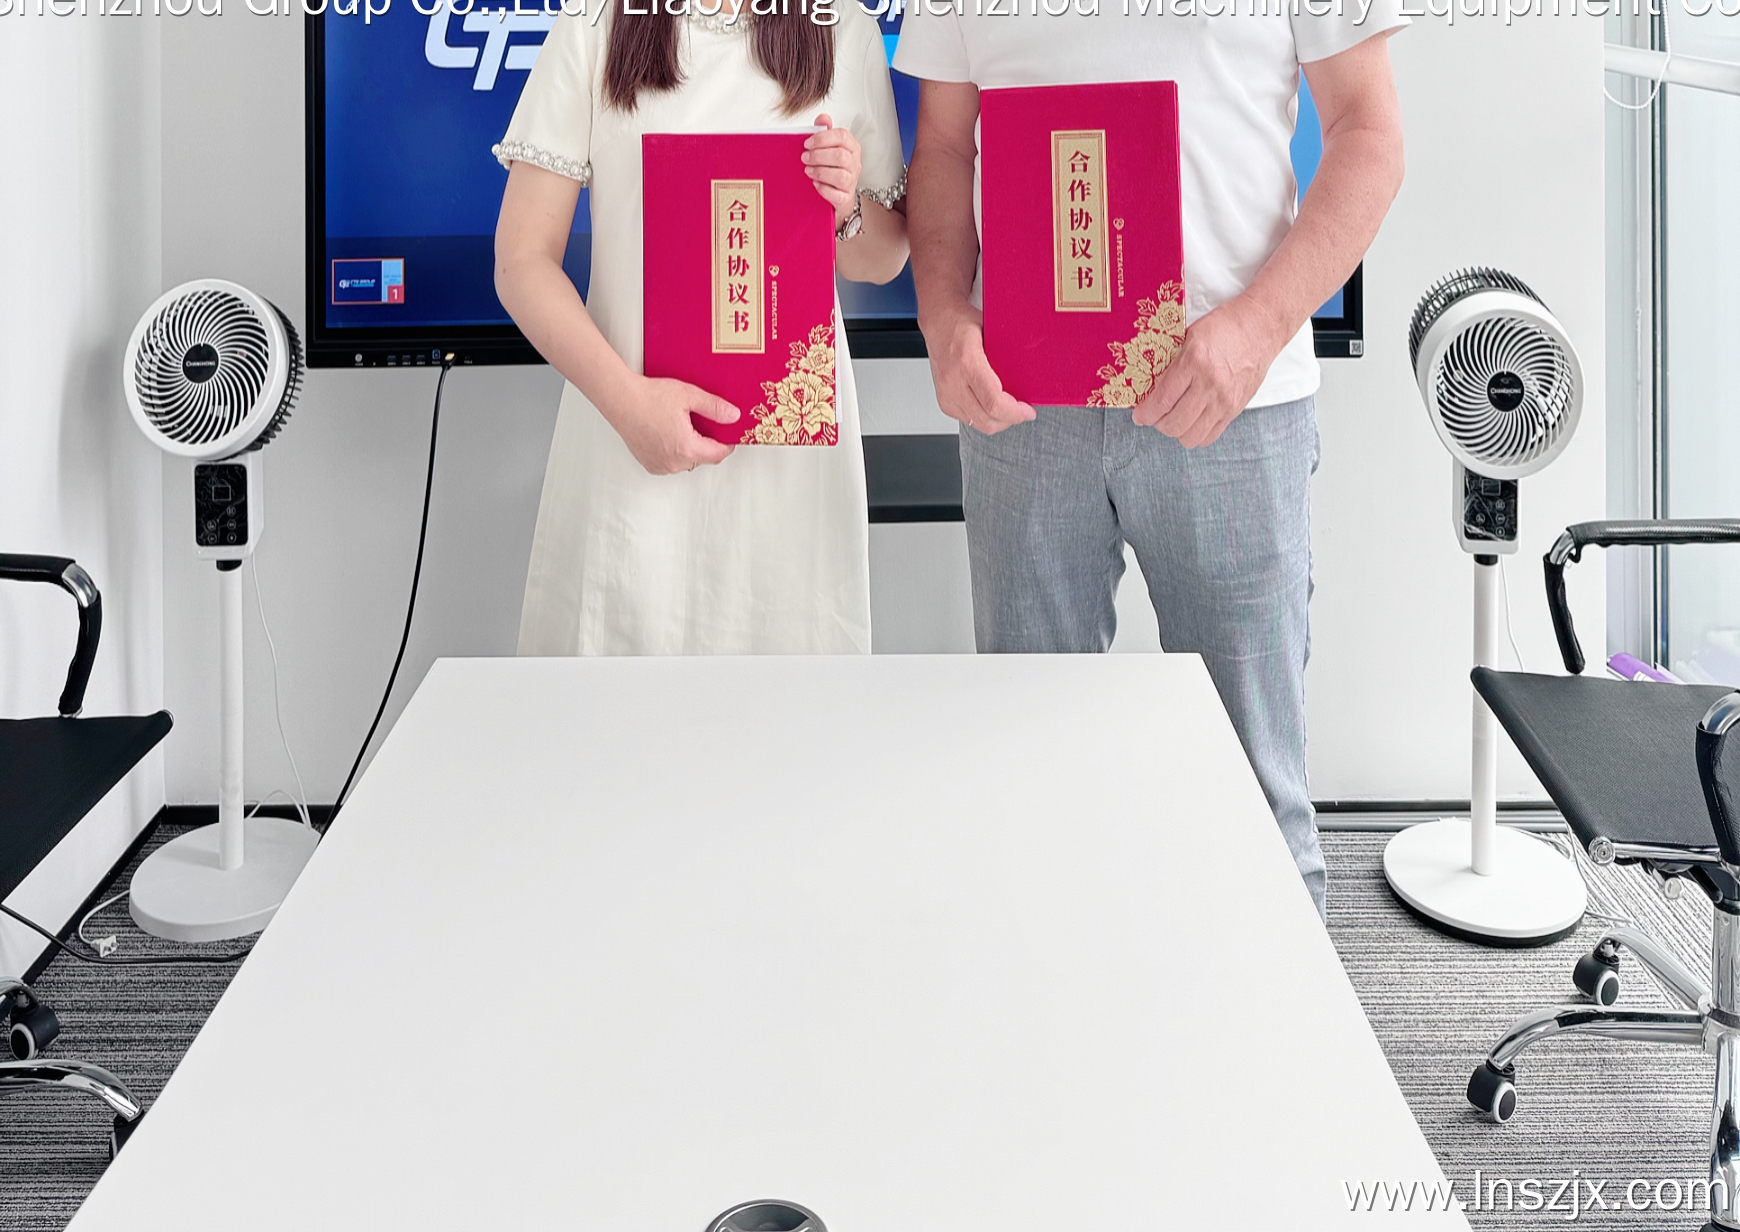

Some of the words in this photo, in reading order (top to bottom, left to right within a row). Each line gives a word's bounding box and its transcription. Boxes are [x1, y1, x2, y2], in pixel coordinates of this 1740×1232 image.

[726, 199, 750, 333] 合作协议书
[1068, 150, 1094, 290] 合作协议书
[1116, 234, 1124, 297] SPECTACULAR
[392, 288, 398, 300] 1
